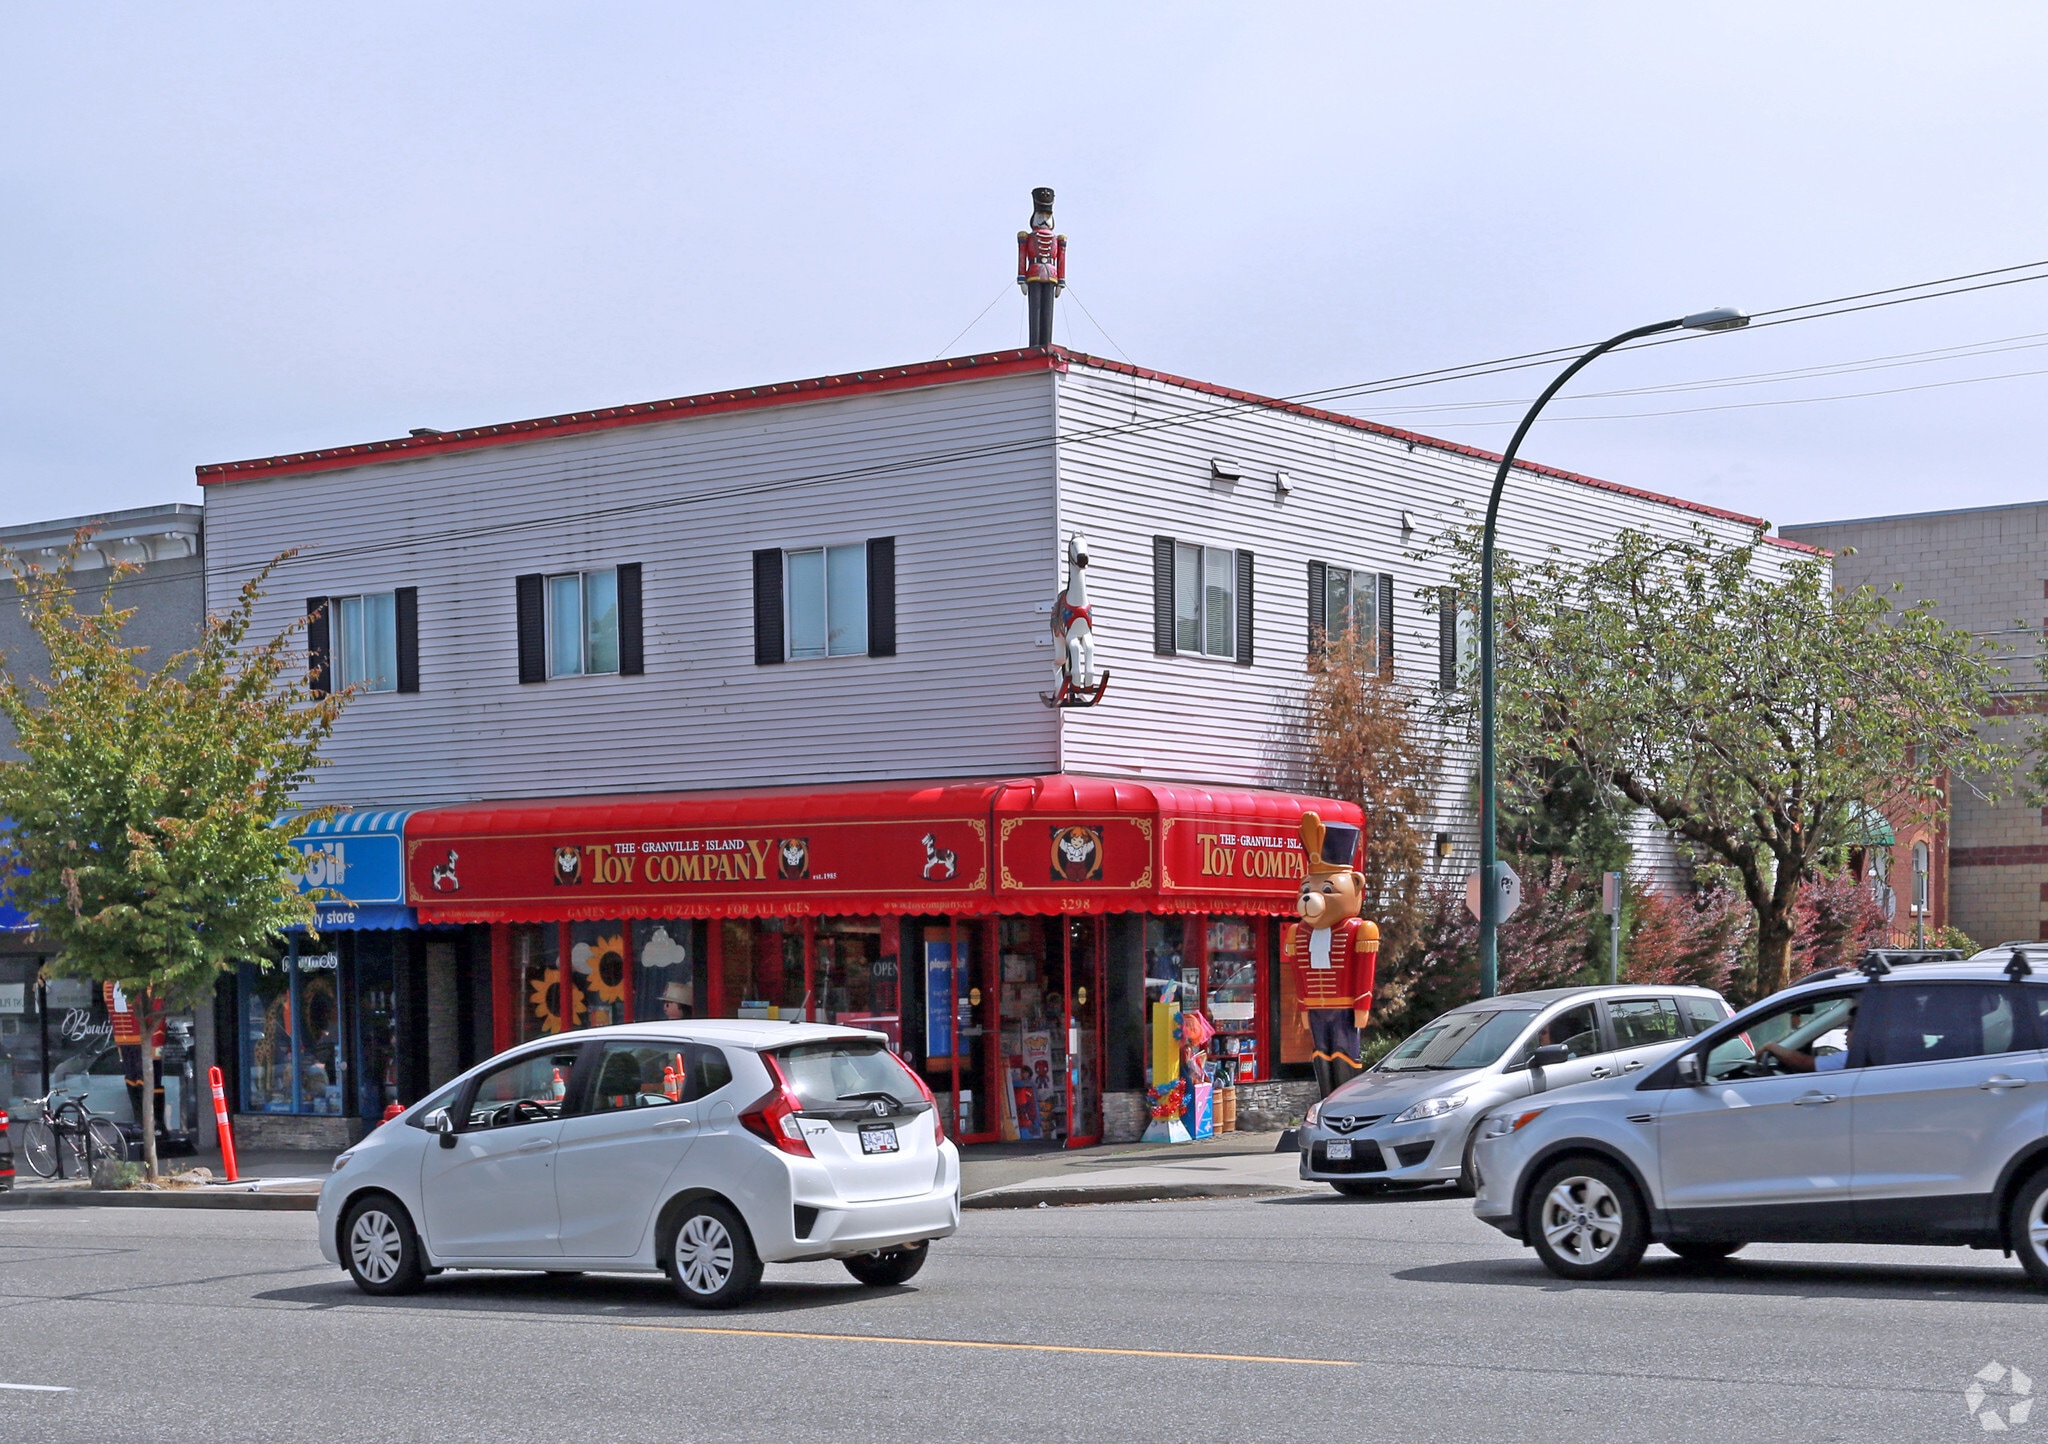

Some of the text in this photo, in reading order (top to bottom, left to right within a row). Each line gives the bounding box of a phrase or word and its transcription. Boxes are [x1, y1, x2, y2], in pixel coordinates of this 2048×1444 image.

[614, 839, 745, 853] THE GRANVILLE ISLAND
[1219, 833, 1236, 845] THE
[1240, 834, 1283, 848] GRANVILLE
[585, 838, 774, 884] TOY COMPANY
[1197, 833, 1306, 879] TOY COMPA
[567, 902, 810, 918] GAMES TOYS PUZZLES FOR ALL AGES
[1060, 898, 1090, 910] 3298
[326, 909, 355, 925] store
